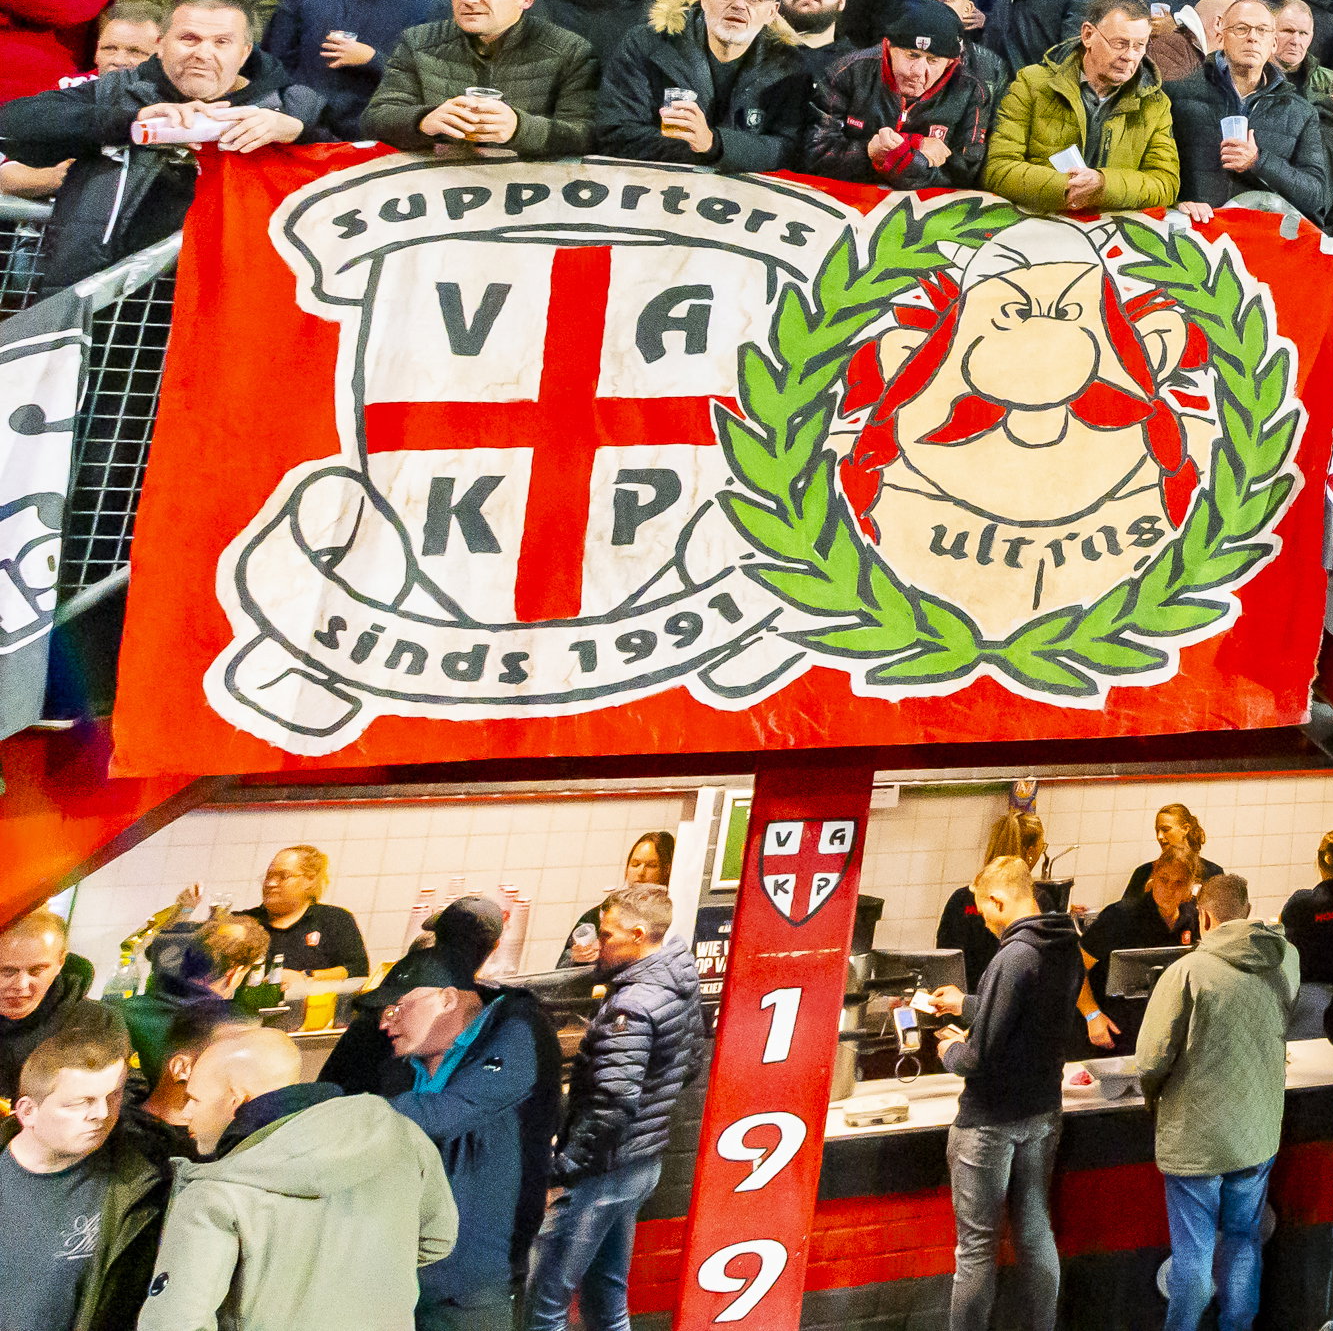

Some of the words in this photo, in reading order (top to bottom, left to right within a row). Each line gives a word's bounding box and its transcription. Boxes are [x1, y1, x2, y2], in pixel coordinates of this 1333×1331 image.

[434, 281, 514, 358] V
[633, 283, 715, 365] A
[420, 474, 506, 557] K
[610, 468, 684, 546] P
[928, 513, 1167, 571] ultras
[312, 613, 535, 687] sinds
[566, 591, 747, 674] 1991
